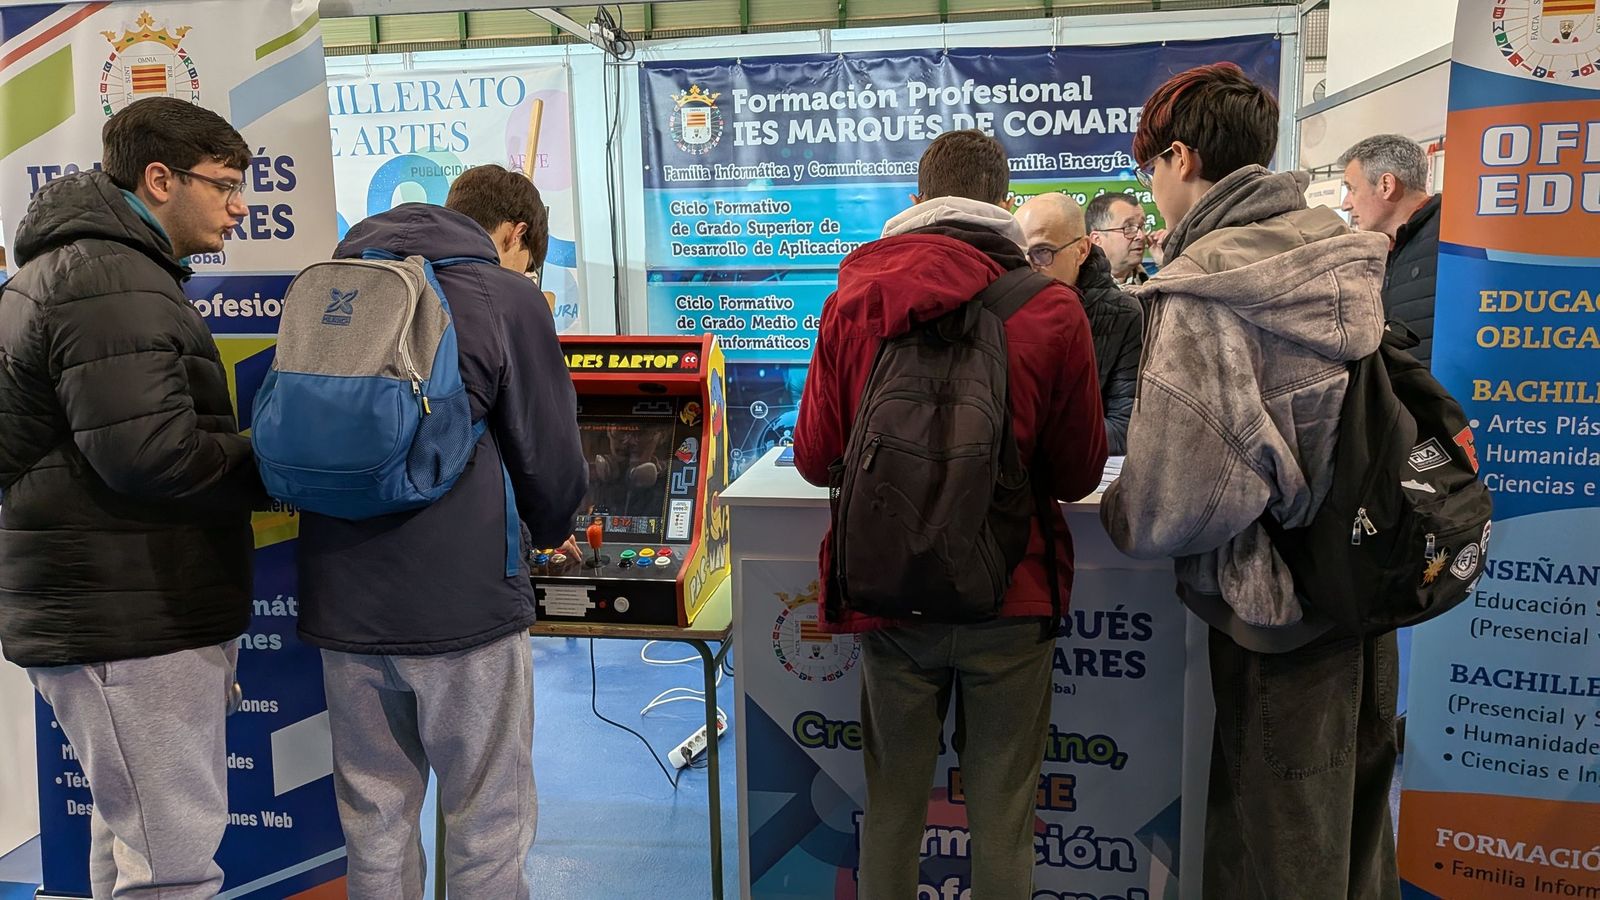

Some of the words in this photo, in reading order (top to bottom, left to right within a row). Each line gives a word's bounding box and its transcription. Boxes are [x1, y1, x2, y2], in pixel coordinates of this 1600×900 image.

[732, 83, 899, 114] Formación
[907, 75, 1093, 107] Profesional
[350, 120, 469, 156] ARTES
[733, 119, 778, 147] IES
[787, 108, 943, 144] MARQUÉS
[1003, 106, 1144, 137] COMARE
[242, 147, 297, 192] ÉS
[411, 164, 475, 178] PUBLICID
[664, 165, 711, 181] Familia
[714, 163, 791, 180] Informática
[793, 165, 804, 180] y
[808, 160, 919, 178] Comunicaciones
[1008, 153, 1056, 171] milia
[1059, 151, 1131, 172] Energía
[670, 201, 708, 215] Ciclo
[715, 199, 791, 215] Formativo
[671, 222, 690, 236] de
[696, 221, 741, 236] Grado
[748, 219, 813, 238] Superior
[820, 218, 839, 233] de
[672, 241, 747, 257] Desarrollo
[754, 241, 772, 256] de
[779, 240, 861, 259] Aplicacion
[190, 292, 284, 318] ofesio
[676, 296, 713, 310] Ciclo
[720, 296, 793, 311] Formativo
[1478, 290, 1600, 313] EDUCA
[677, 316, 695, 330] de
[701, 316, 745, 330] Grado
[752, 315, 797, 330] Medio
[718, 335, 810, 350] informáticos
[608, 354, 679, 369] BARTOP
[1472, 379, 1600, 404] BACHIL
[1487, 414, 1547, 435] Artes
[1486, 444, 1600, 466] Humanida
[1484, 473, 1575, 495] Ciencias
[1584, 481, 1596, 496] e
[1484, 556, 1600, 586] NSEÑAN
[1475, 590, 1586, 616] Educación
[1470, 617, 1588, 645] (Presencial
[1450, 663, 1600, 697] BACHILLE
[1448, 693, 1564, 725] (Presencial
[1574, 713, 1586, 730] y
[793, 711, 862, 750] Cre
[1464, 723, 1600, 755] Humanidade
[227, 752, 254, 769] des
[1461, 751, 1549, 779] Ciencias
[1558, 767, 1569, 781] e
[1578, 765, 1600, 788] In
[261, 810, 293, 829] Web
[1452, 859, 1526, 889] Familia
